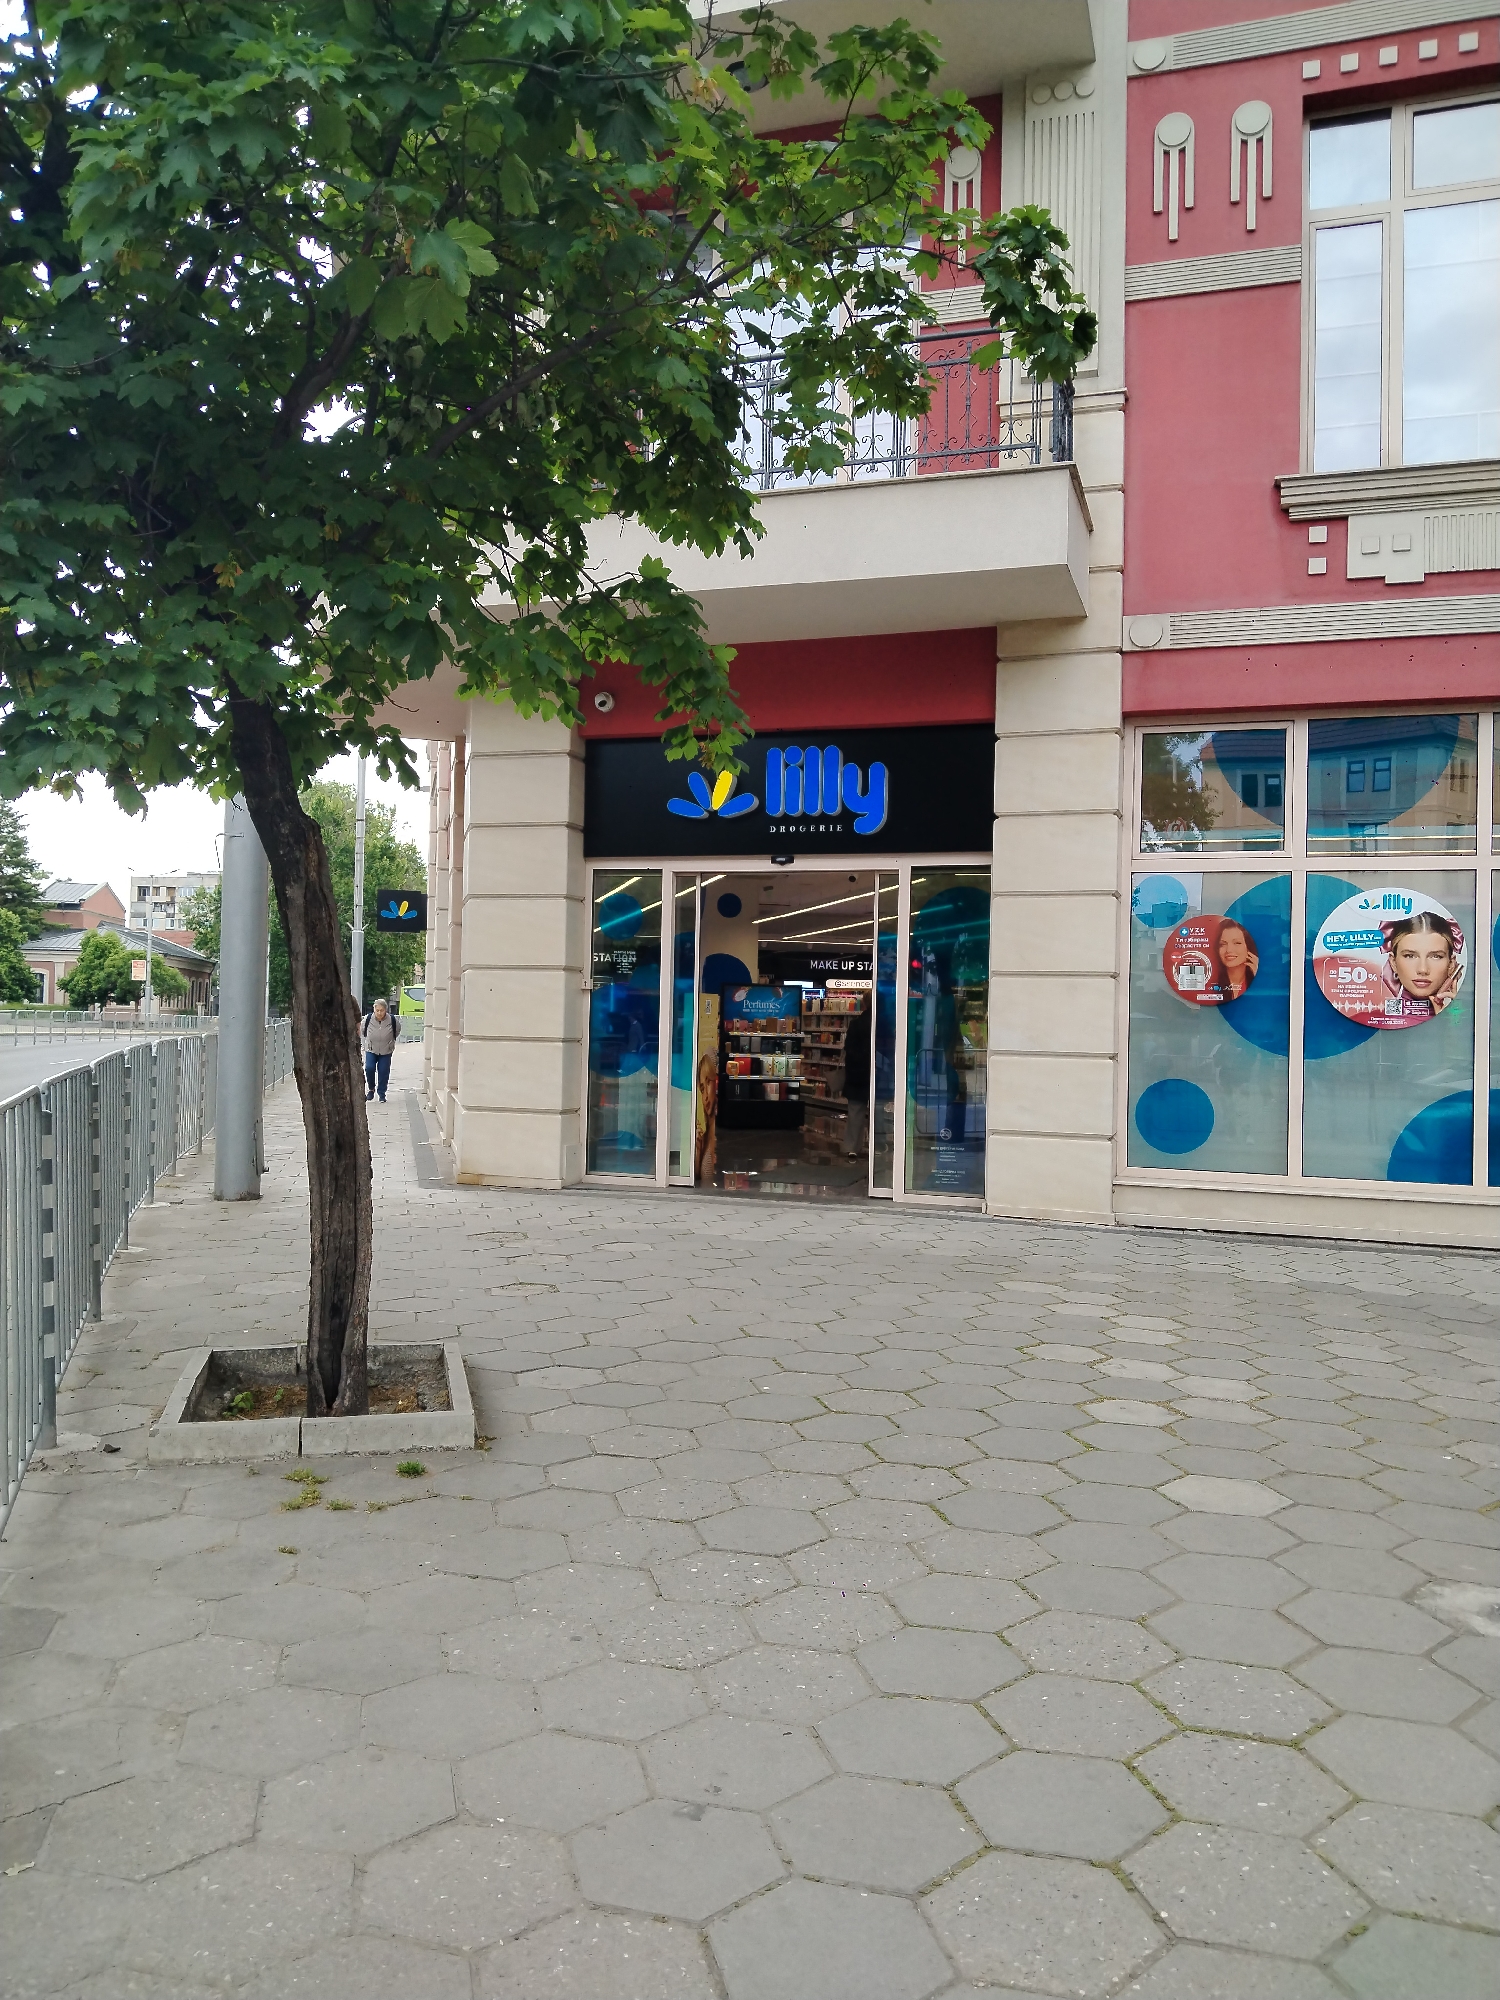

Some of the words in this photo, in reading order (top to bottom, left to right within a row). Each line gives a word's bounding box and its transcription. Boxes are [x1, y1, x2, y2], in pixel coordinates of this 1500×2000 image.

[766, 745, 888, 835] lilly
[770, 825, 843, 833] DROGERIE
[1382, 893, 1413, 915] lilly
[1326, 934, 1348, 943] HEY,
[810, 960, 839, 970] MAKE
[841, 961, 855, 971] UP
[743, 1000, 781, 1009] Perfumes
